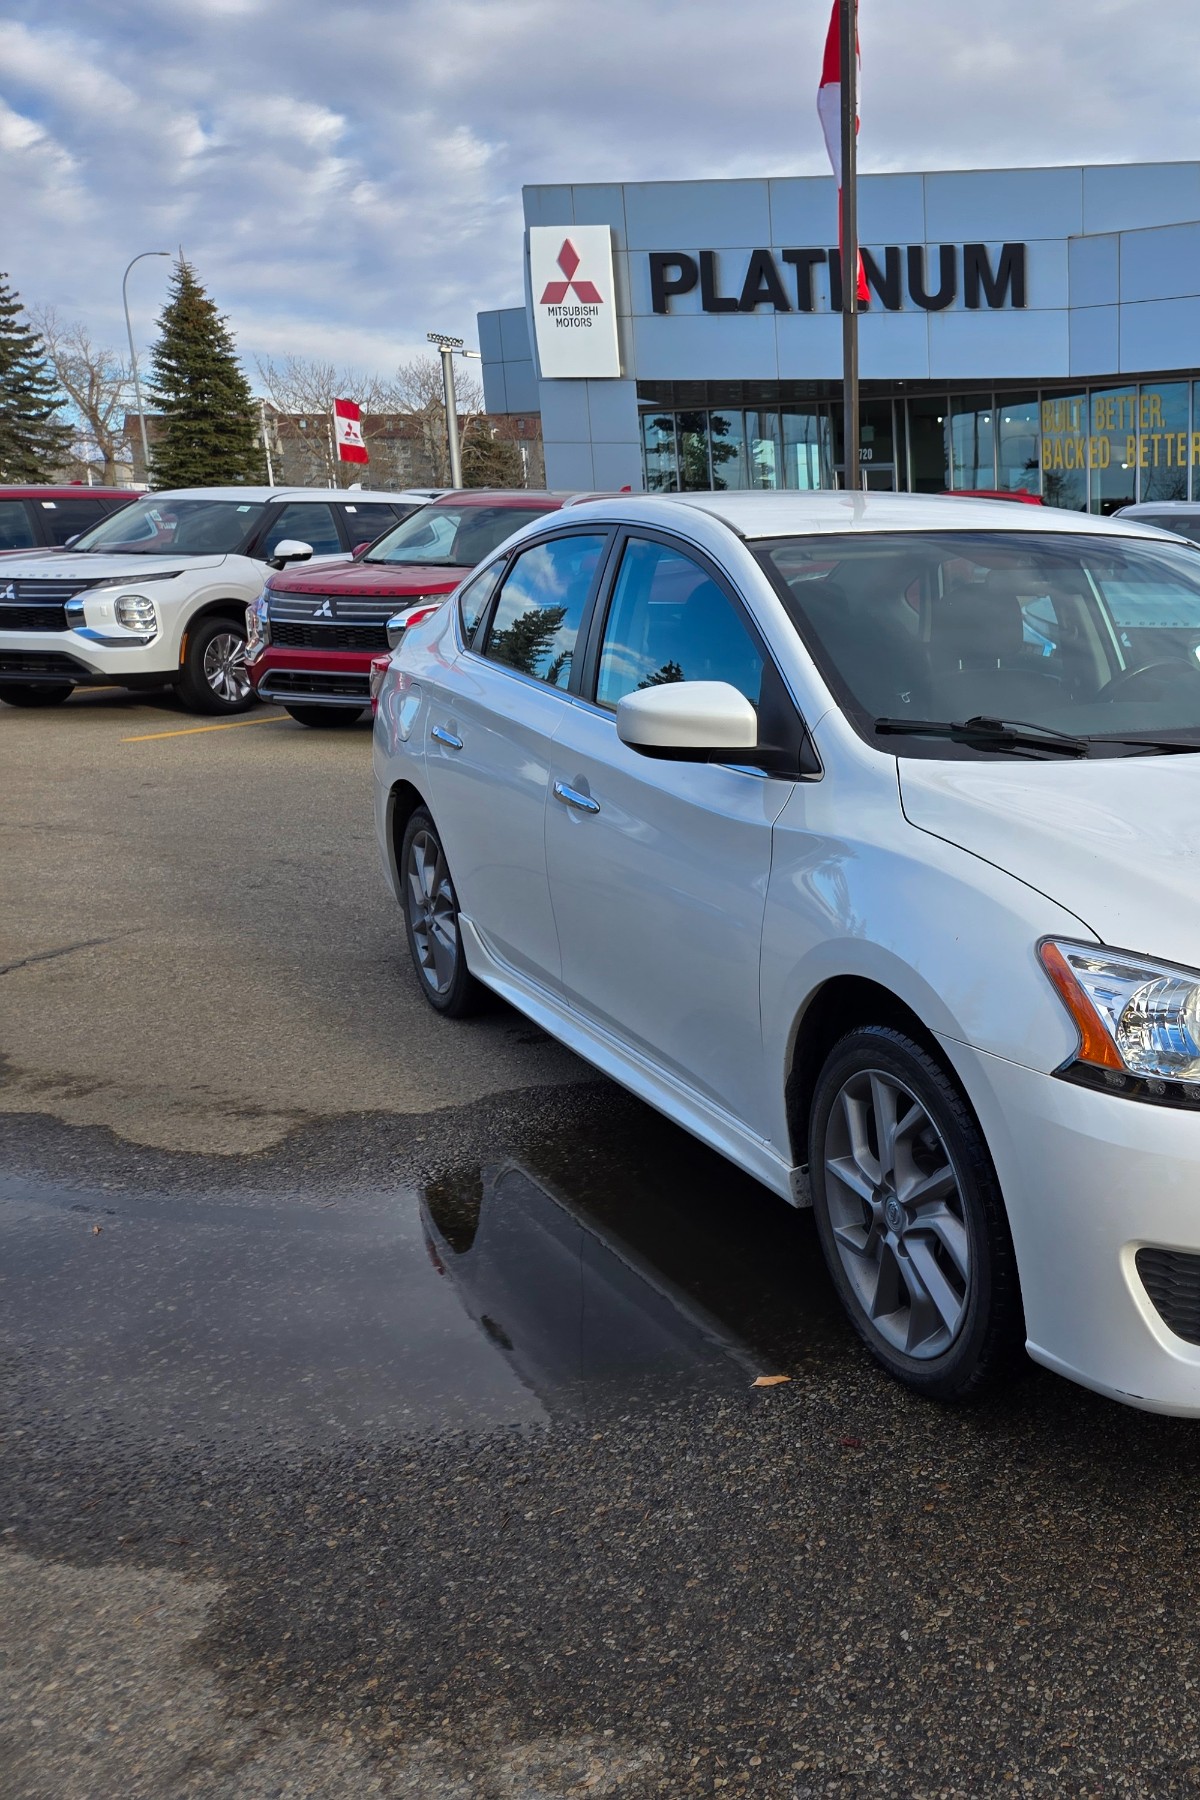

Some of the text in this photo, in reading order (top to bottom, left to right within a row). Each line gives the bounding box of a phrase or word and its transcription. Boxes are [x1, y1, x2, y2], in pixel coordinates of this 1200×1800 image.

[649, 243, 1027, 313] PLATINUM
[547, 306, 599, 316] MITSUBISHI
[556, 318, 592, 328] MOTORS
[1042, 394, 1166, 432] BUILT BETTER.
[1042, 435, 1110, 470] BACKED
